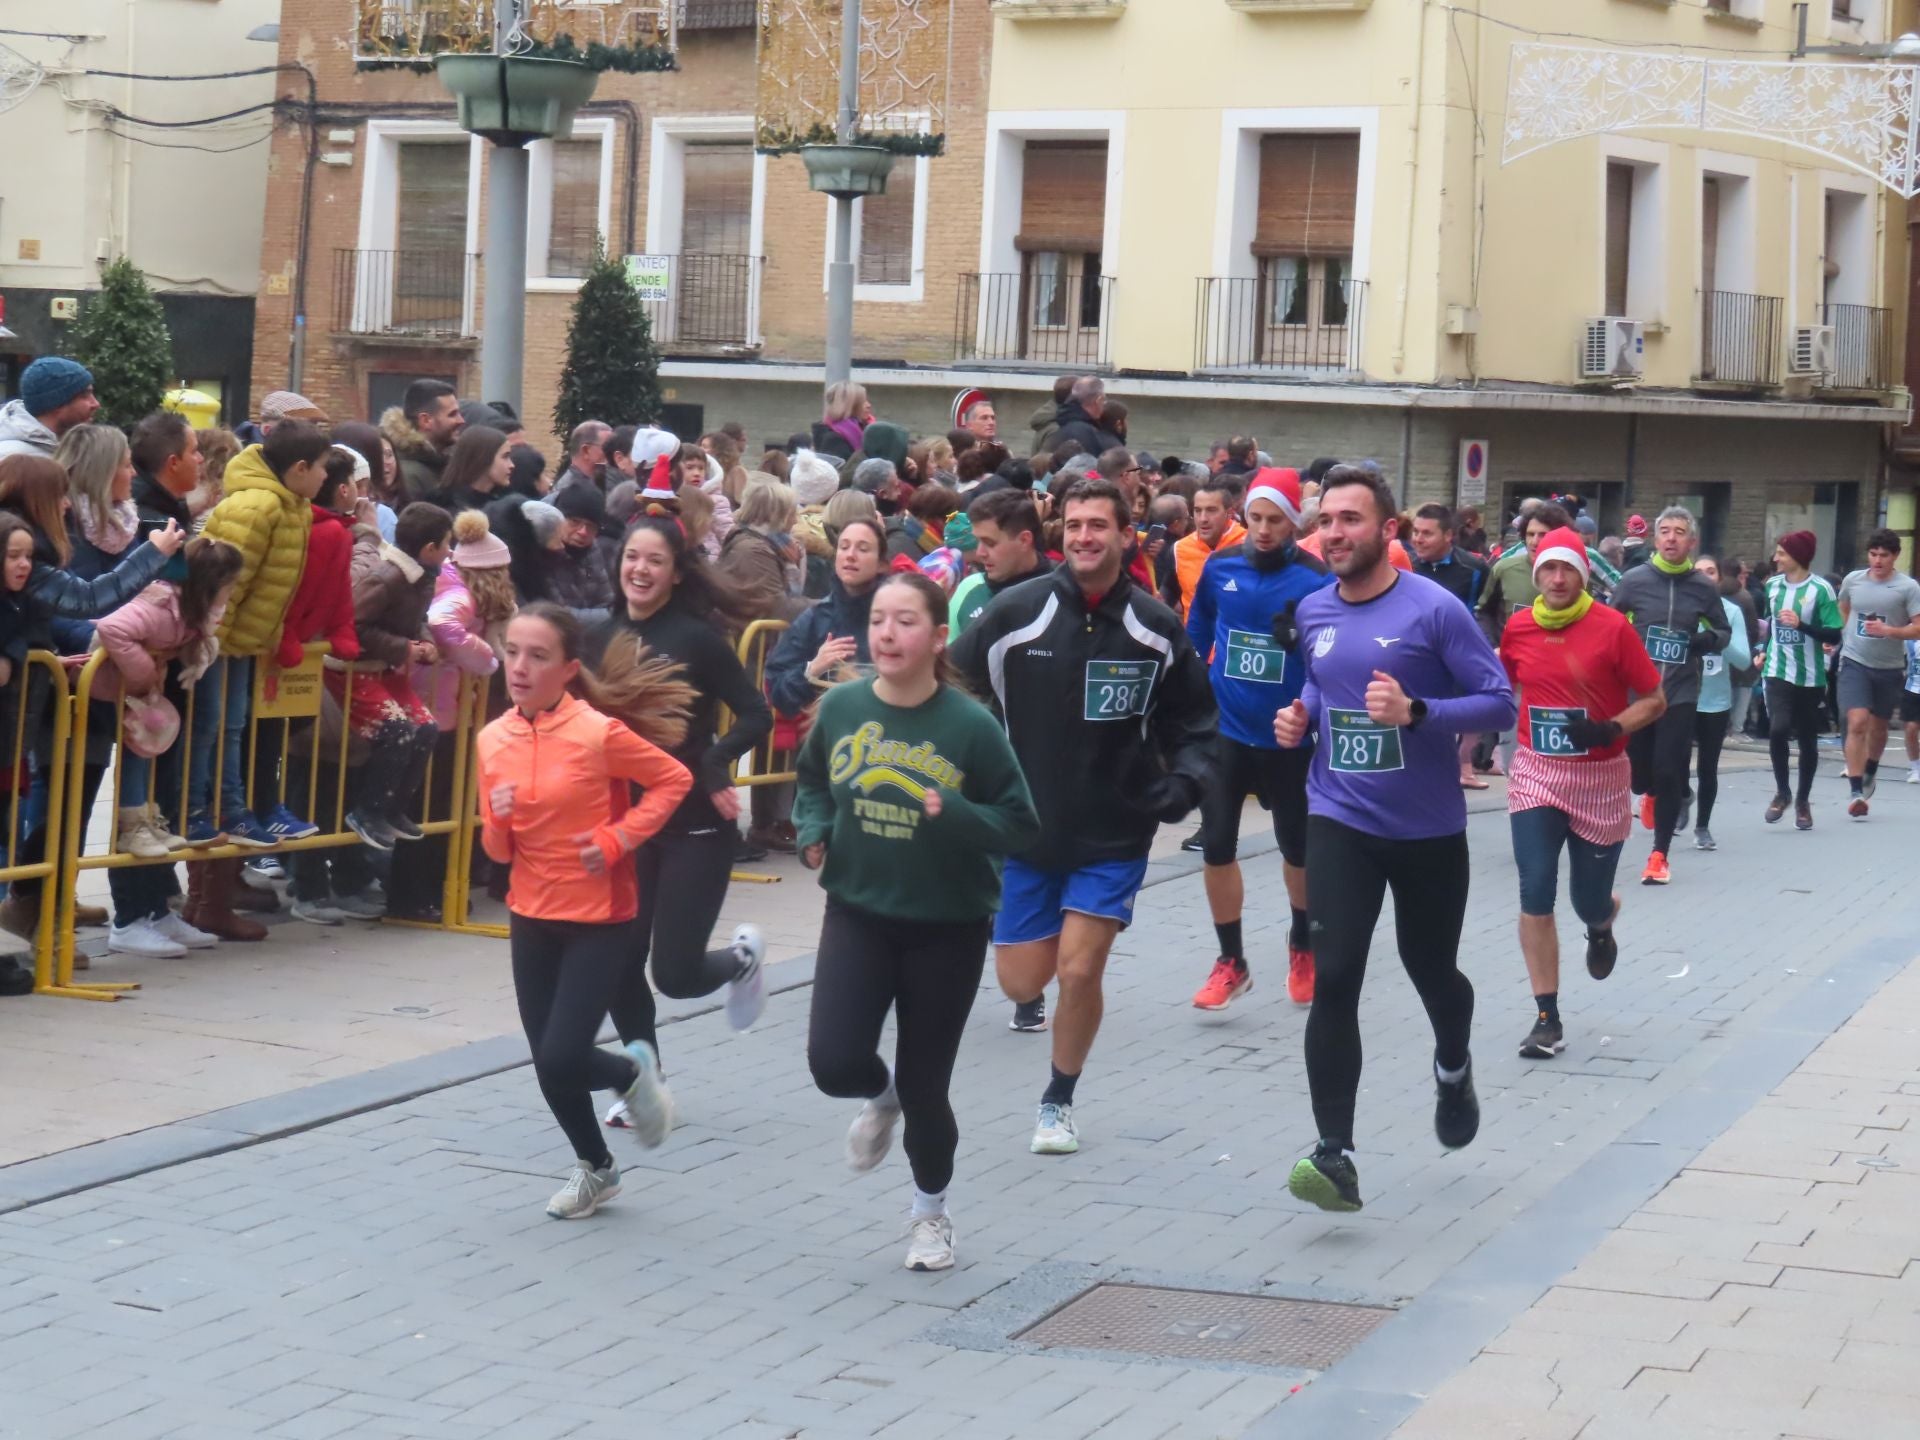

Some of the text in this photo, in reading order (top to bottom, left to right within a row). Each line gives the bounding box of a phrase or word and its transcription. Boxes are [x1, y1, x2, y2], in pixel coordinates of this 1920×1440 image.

[636, 256, 667, 269] INTEC
[629, 275, 661, 286] VENDE
[1778, 629, 1800, 643] 298
[1655, 640, 1681, 659] 190
[1240, 651, 1266, 676] 80
[1099, 685, 1140, 713] 286
[1338, 734, 1383, 765] 287
[853, 798, 920, 827] FUNDAY
